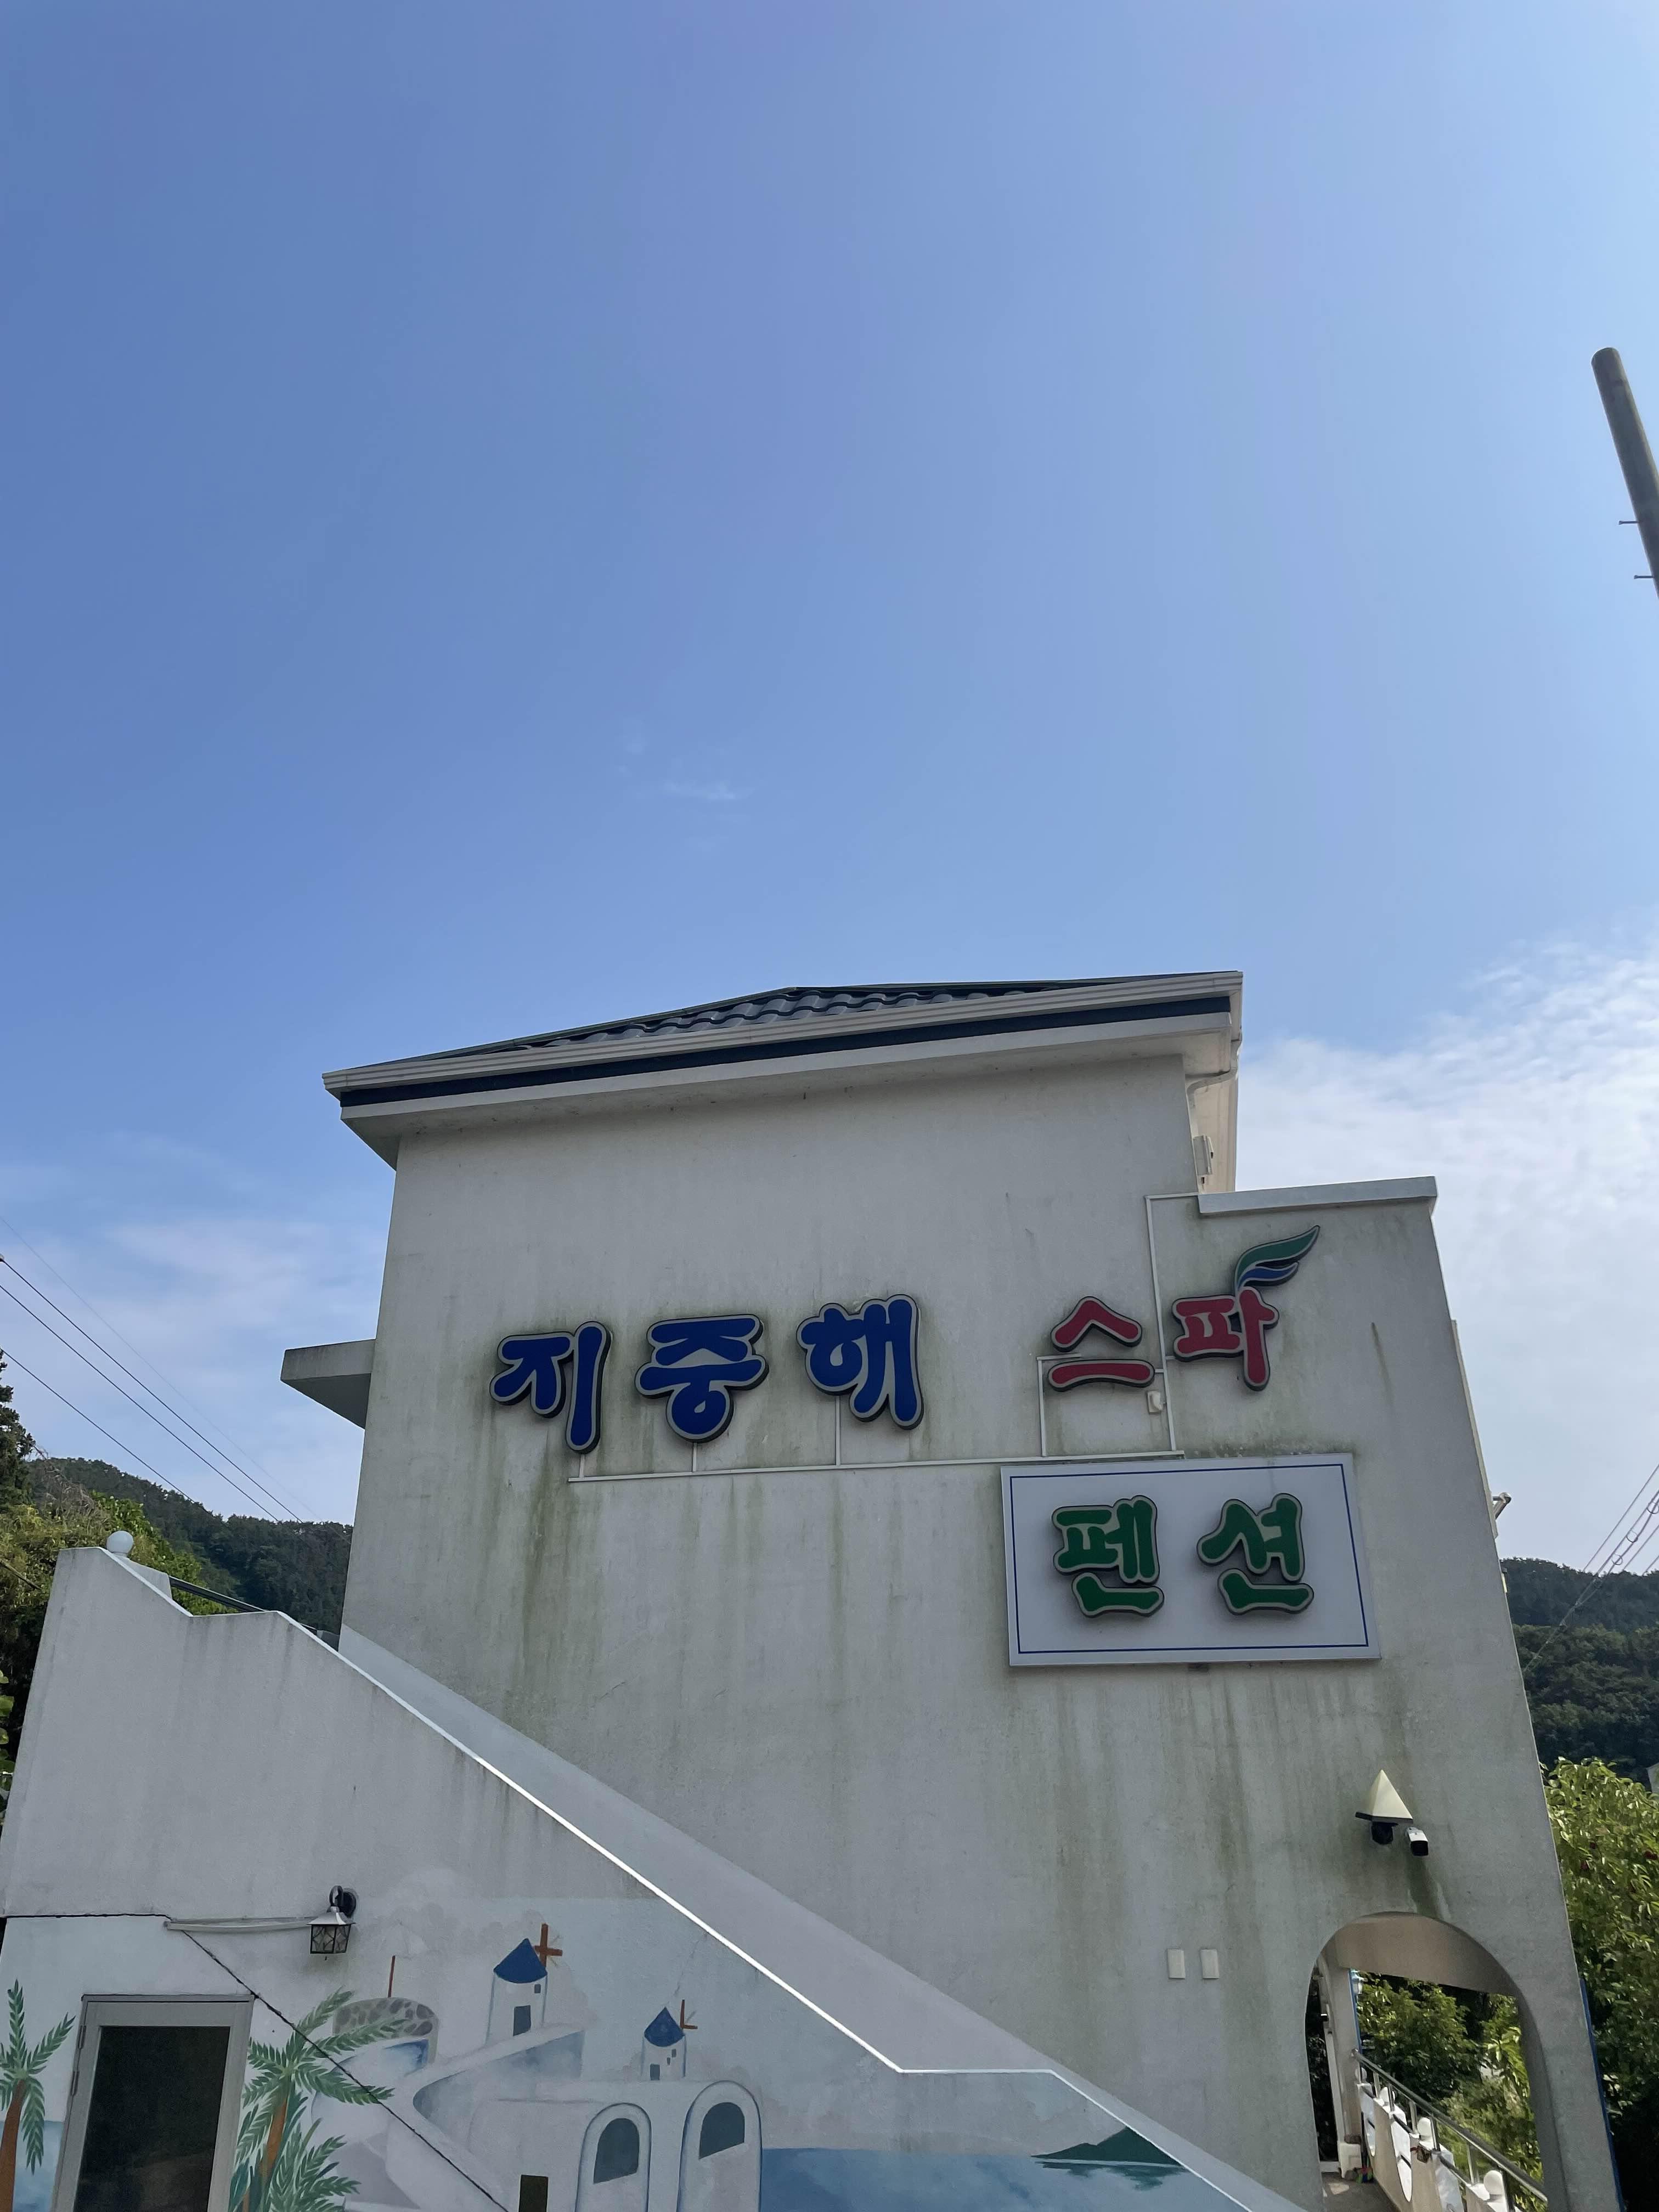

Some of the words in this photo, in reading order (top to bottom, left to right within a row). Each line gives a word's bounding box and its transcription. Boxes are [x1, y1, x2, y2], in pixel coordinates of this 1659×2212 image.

[489, 1294, 923, 1454] 지중해
[1048, 1286, 1279, 1392] 스파
[1052, 1493, 1314, 1618] 펜션
